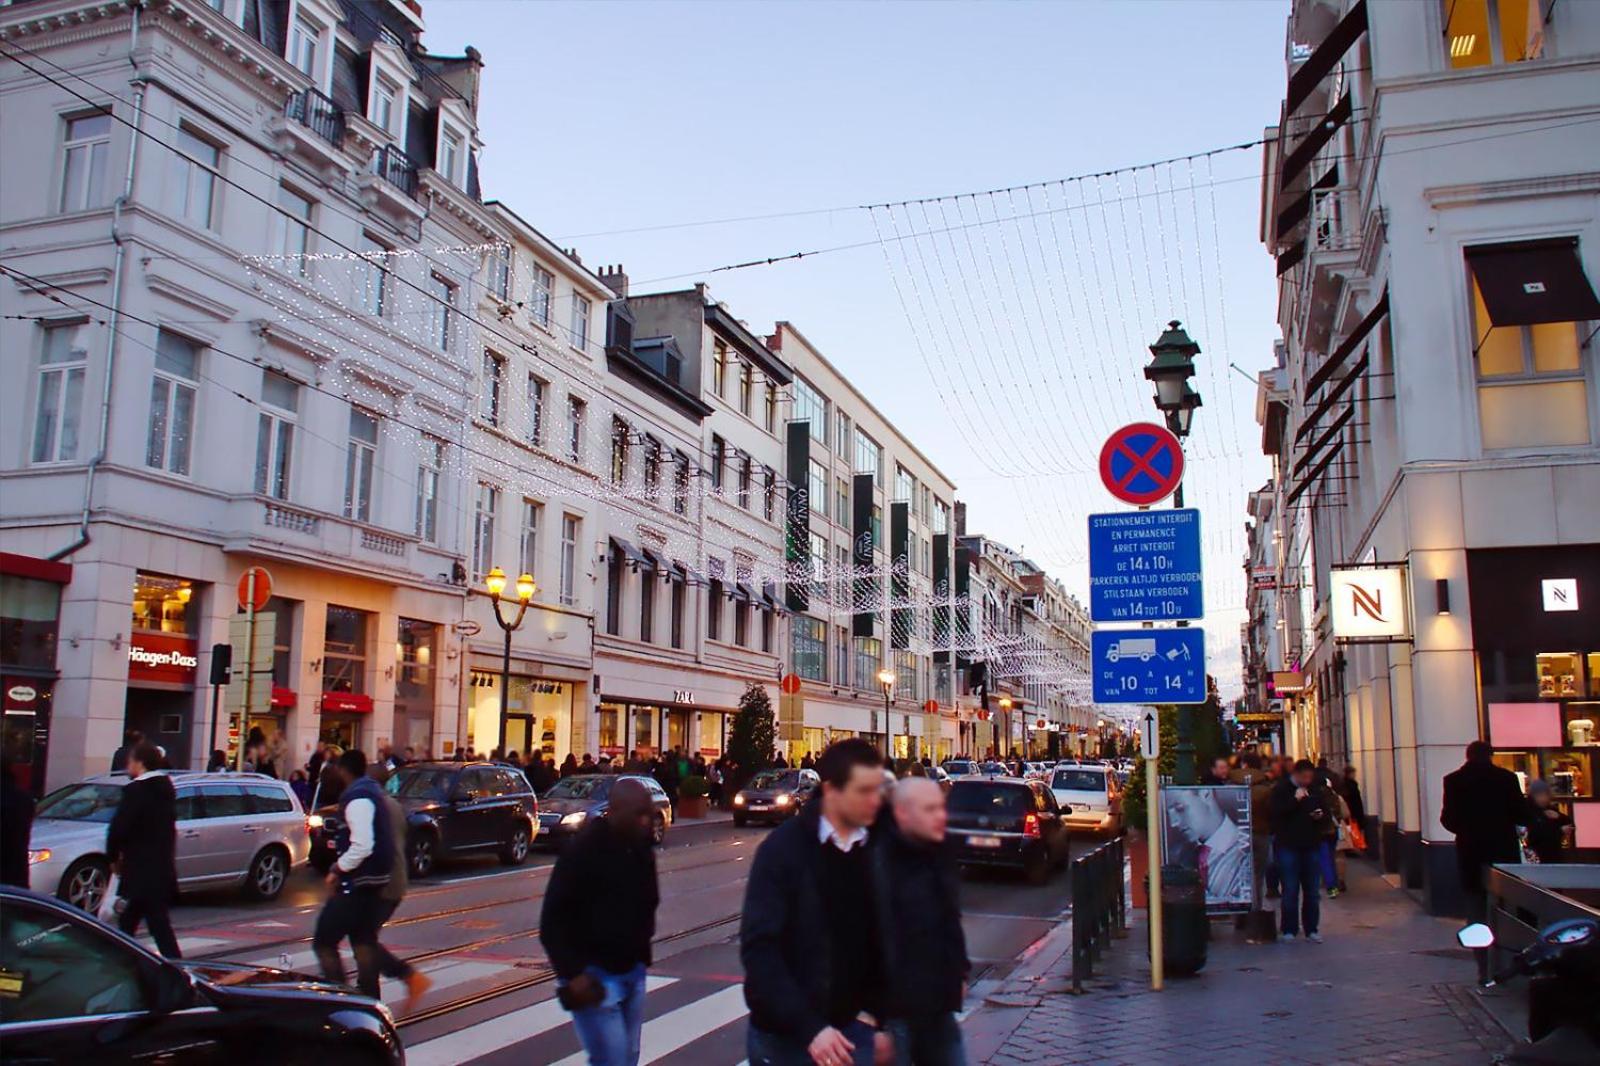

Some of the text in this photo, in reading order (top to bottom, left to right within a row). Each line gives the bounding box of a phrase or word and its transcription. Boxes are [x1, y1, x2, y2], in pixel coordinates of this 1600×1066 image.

[798, 488, 808, 519] INNO
[1094, 513, 1193, 528] STATIONNEMENT INTERDIT
[1111, 528, 1176, 540] EN PERMANENCE
[863, 530, 872, 558] INNO
[1113, 541, 1175, 553] ARRET INTERDIT
[1117, 555, 1173, 571] DE 14 A 10 H
[1090, 572, 1202, 586] PARKEREN ALTIJD VERBODEN
[1103, 587, 1189, 599] STILSTAAN VERBODEN
[1112, 608, 1128, 617] VAN
[1130, 602, 1143, 616] 14
[1144, 607, 1158, 616] TOT
[1161, 601, 1175, 615] 10
[128, 646, 197, 667] Häagen-Dazs
[1120, 675, 1182, 690] 10 14
[674, 690, 695, 704] ZARA
